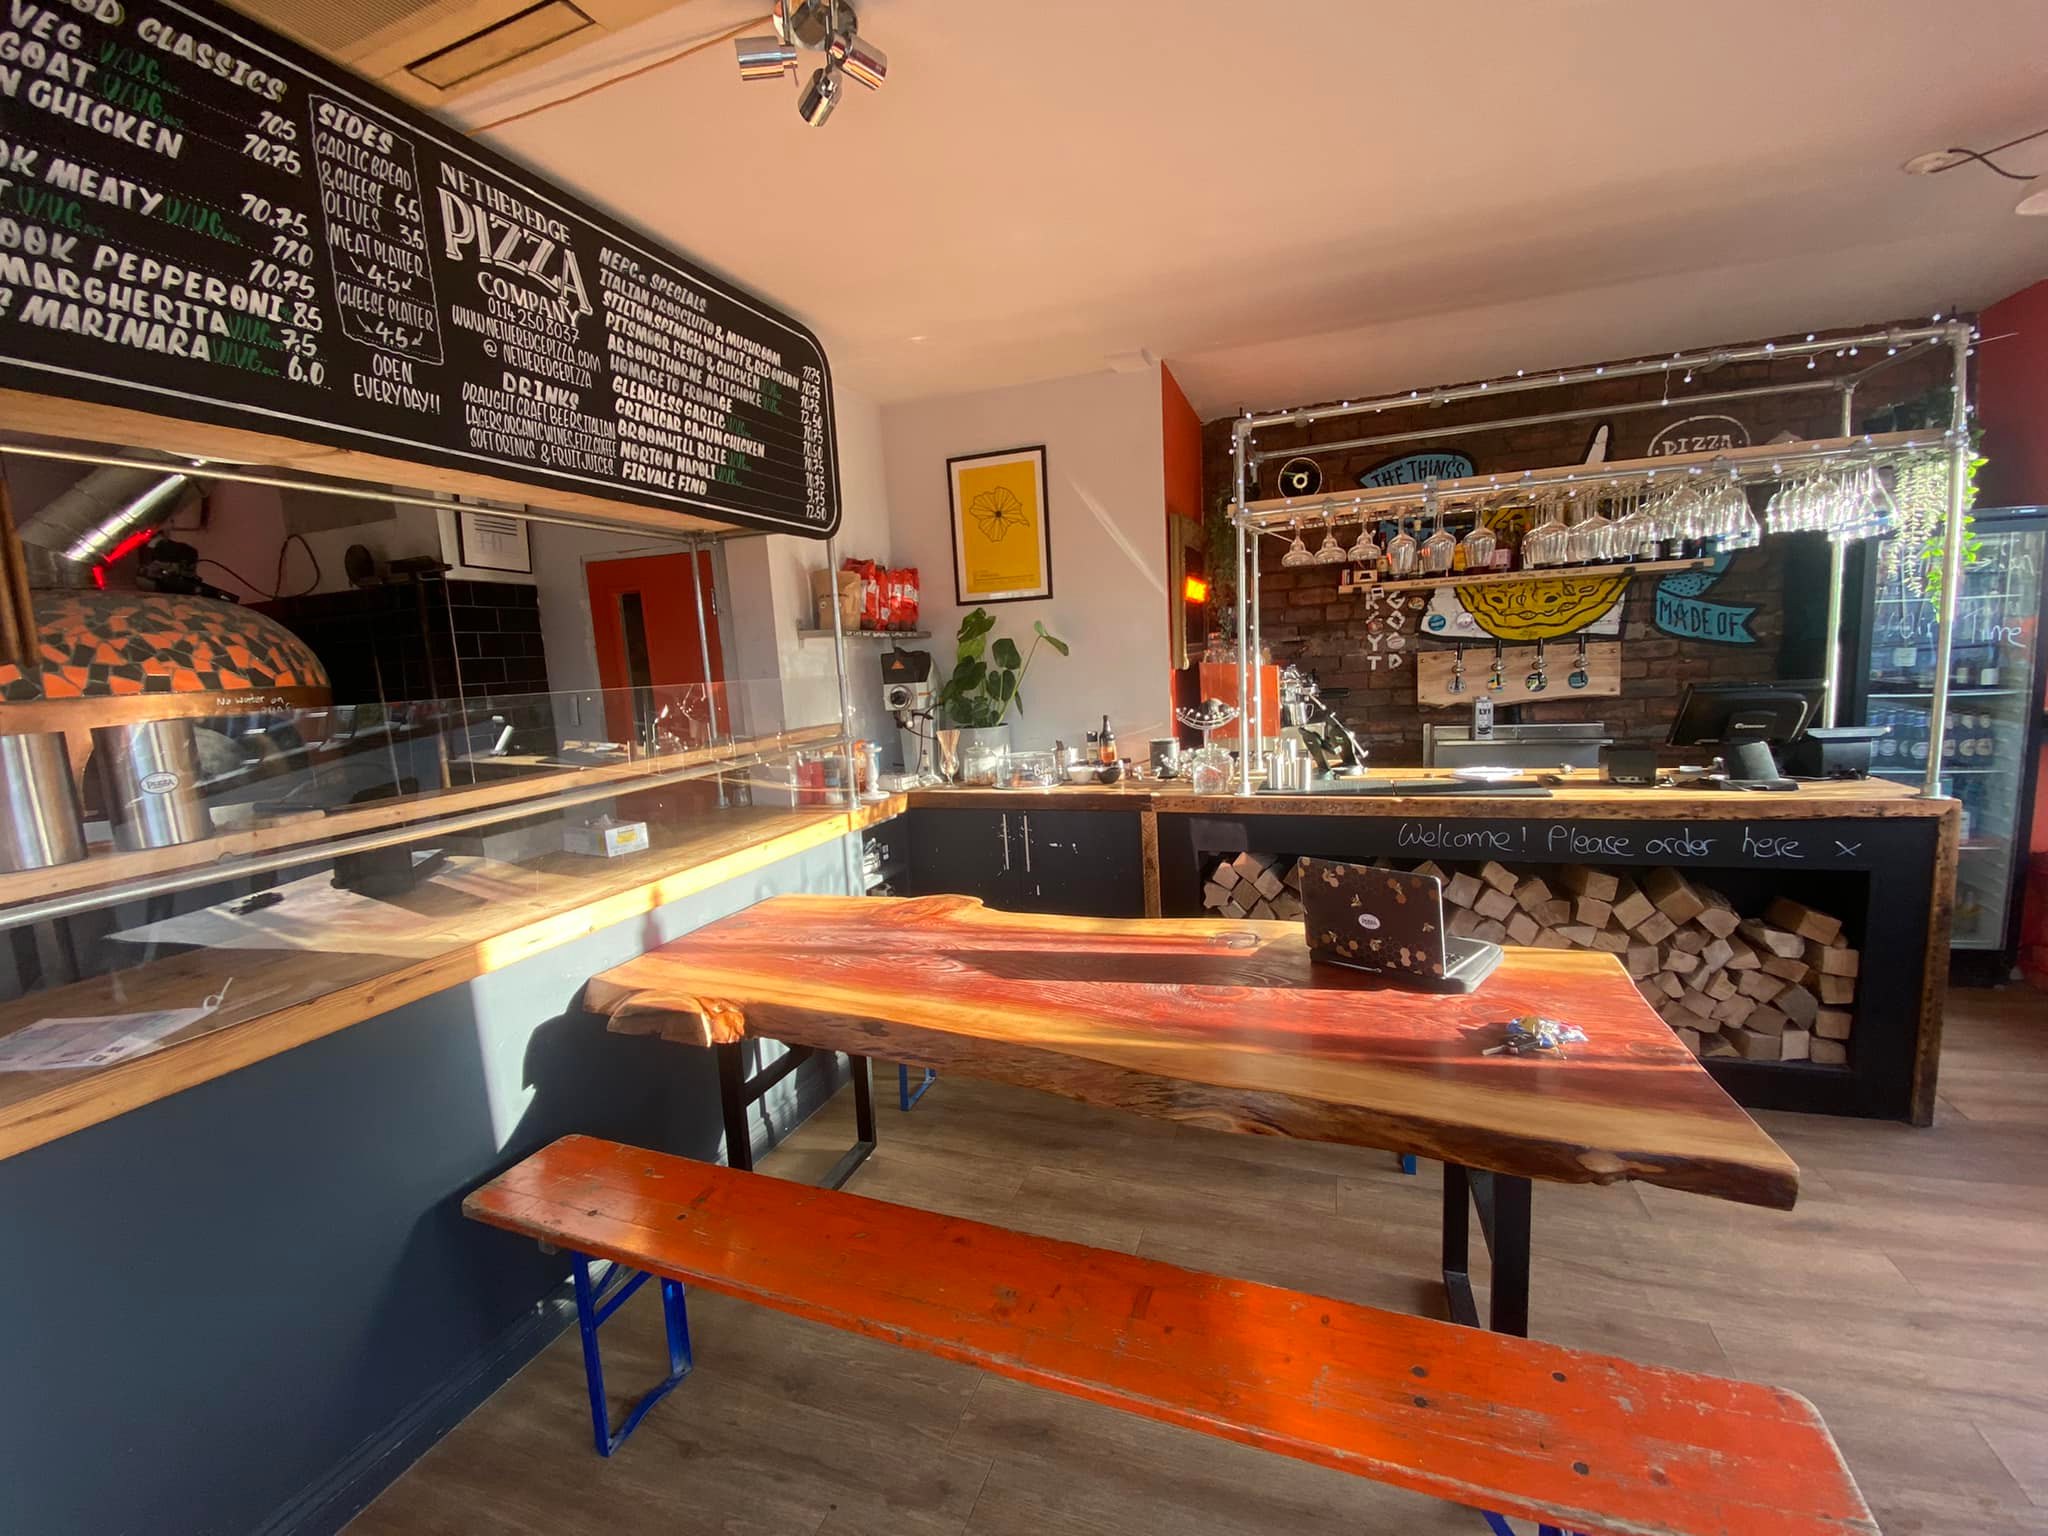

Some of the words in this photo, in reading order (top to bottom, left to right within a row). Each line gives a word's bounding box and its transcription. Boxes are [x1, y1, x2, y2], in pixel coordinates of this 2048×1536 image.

[137, 17, 288, 103] CLASSICS
[0, 31, 97, 88] GOAT
[242, 133, 302, 176] 10.75
[28, 79, 184, 160] CHICKEN
[318, 102, 393, 155] SIDES
[316, 131, 369, 173] GARLIC
[371, 155, 412, 191] BREAD
[44, 158, 164, 216] MEATY
[394, 193, 420, 223] 5.5
[240, 193, 309, 237] 10.75
[325, 190, 381, 233] OLIVES
[399, 224, 424, 251] 3.5
[329, 223, 371, 260] MEAT
[374, 239, 424, 277] PLATTER
[436, 186, 593, 317] PIZZA
[92, 244, 285, 323] PEPPERONI
[248, 259, 316, 299] 10.75
[367, 264, 401, 293] 4.5
[477, 271, 580, 327] COMPANY
[649, 273, 707, 313] SPECIALS
[338, 281, 384, 317] CHEESE
[388, 297, 434, 332] PLATTER
[488, 297, 516, 322] 0114
[517, 309, 545, 332] 250
[545, 318, 580, 345] 8037
[599, 268, 649, 306] ITALIAN
[651, 295, 714, 335] PROSCIUTTO
[714, 325, 725, 342] &
[726, 330, 781, 367] MUSHROOM
[19, 295, 211, 362] MARINARA
[288, 355, 325, 386] 6.0
[280, 328, 318, 358] 7.5
[375, 321, 409, 349] 4.5
[605, 311, 671, 353] PITSMOOR
[673, 340, 705, 366] PESTO
[706, 356, 716, 374] &
[716, 359, 761, 389] CHICKEN
[372, 353, 414, 385] OPEN
[502, 371, 580, 411] DRINKS
[607, 333, 702, 385] ARBOURTHORNE
[705, 373, 762, 408] ARTICHOKE
[771, 369, 800, 391] ONION
[462, 382, 515, 413] DRAUGHT
[516, 397, 548, 423] CRAFT
[612, 375, 684, 415] GLEADLESS
[683, 401, 726, 430] GARLIC
[682, 381, 733, 413] FROMAGE
[495, 433, 536, 459] DRINKS
[540, 443, 551, 466] &
[615, 398, 682, 433] CRIMICAR
[684, 420, 723, 446] CAJUN
[723, 433, 766, 458] CHICKEN
[617, 418, 695, 456] BROOMHILL
[697, 442, 727, 465] BRIE
[620, 442, 673, 469] NORTON
[677, 458, 716, 481] NAPOLI
[1370, 463, 1404, 487] THE
[678, 476, 708, 496] FINO
[1659, 597, 1713, 635] MADE
[1716, 611, 1744, 637] OF
[1547, 823, 1636, 859] Please
[1644, 827, 1719, 857] order
[1742, 826, 1805, 859] here
[1834, 840, 1863, 857] x
